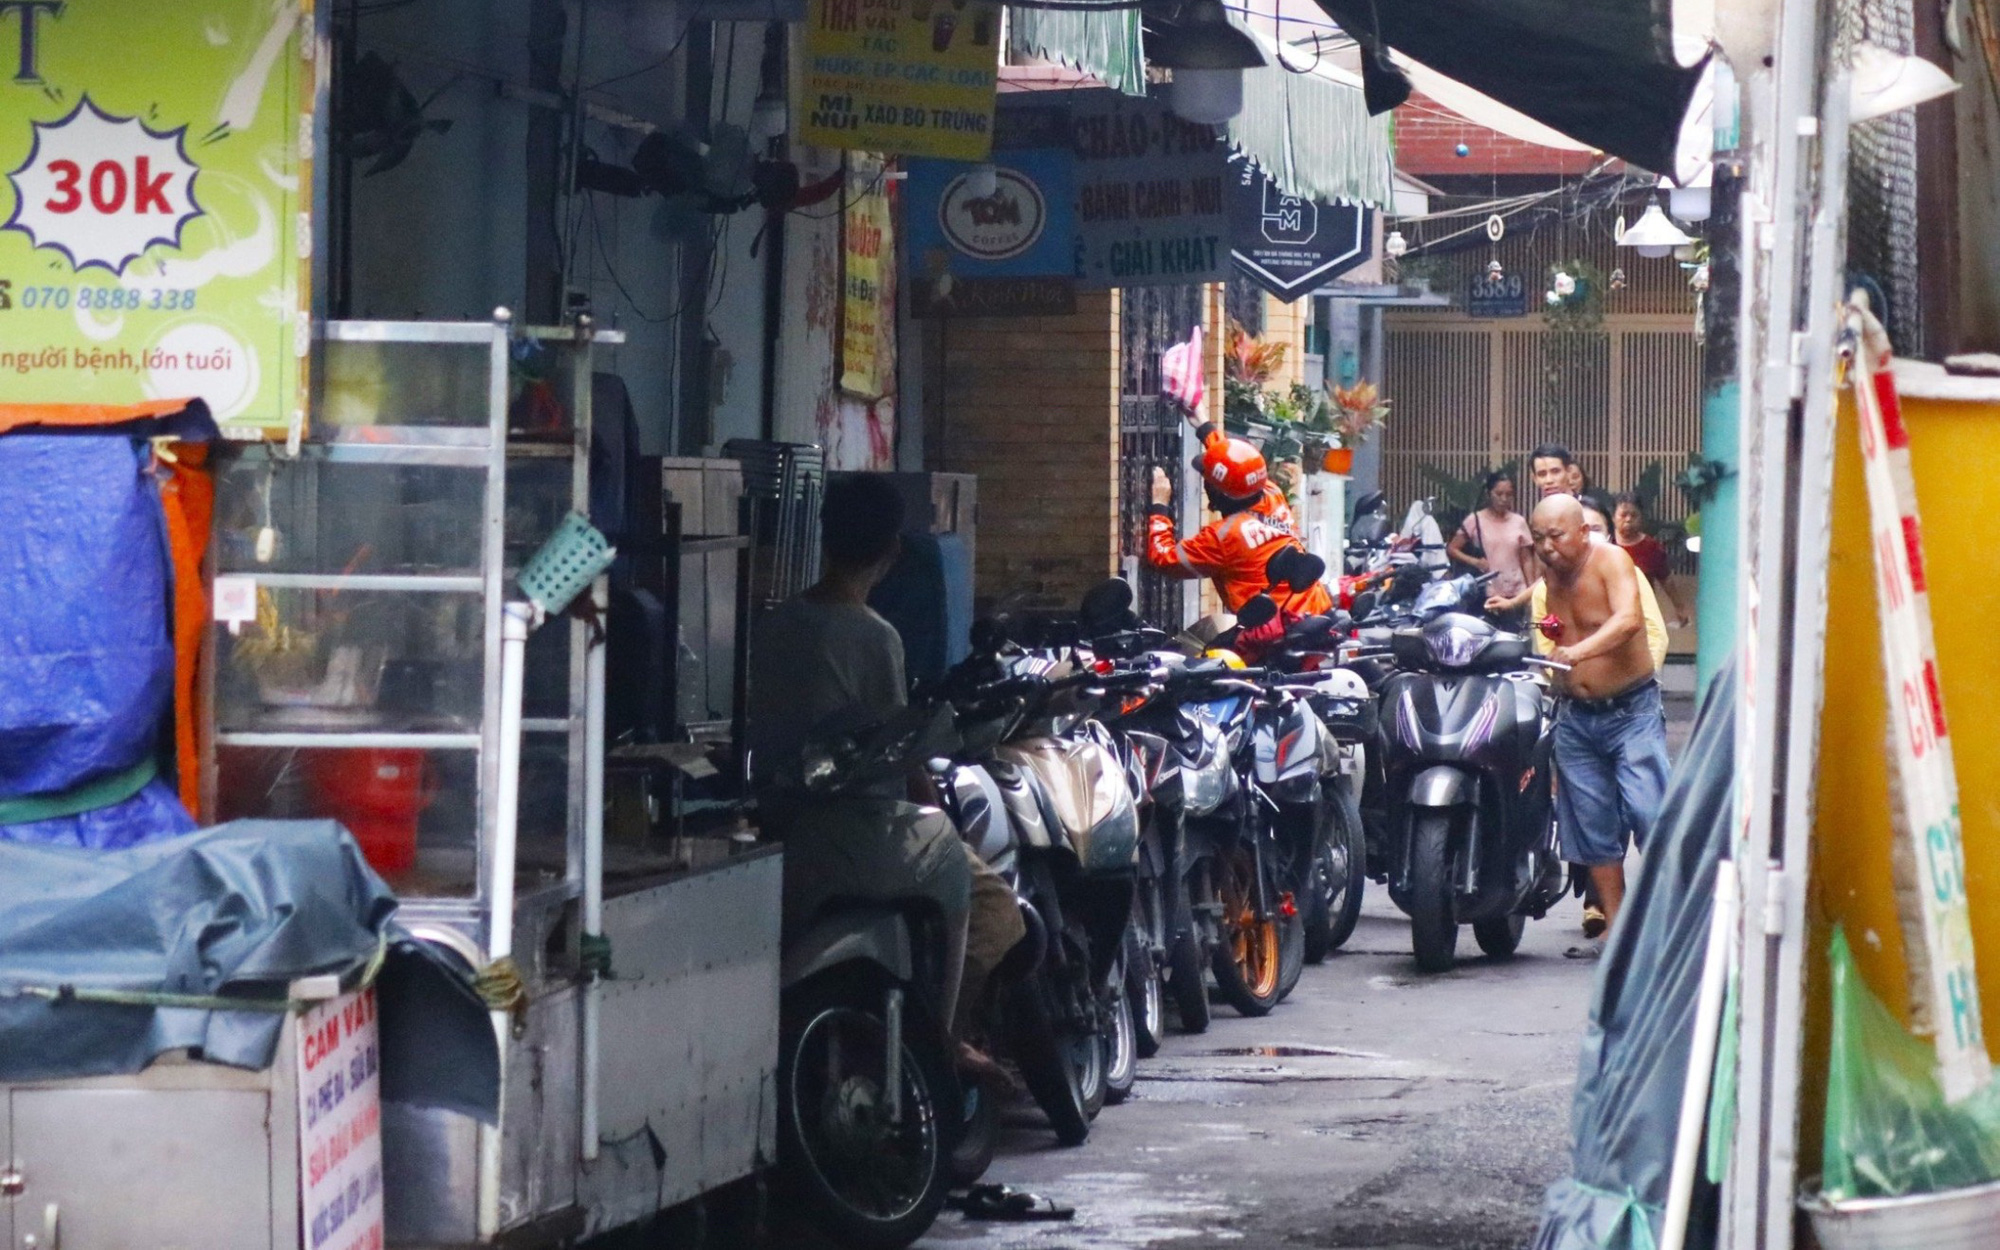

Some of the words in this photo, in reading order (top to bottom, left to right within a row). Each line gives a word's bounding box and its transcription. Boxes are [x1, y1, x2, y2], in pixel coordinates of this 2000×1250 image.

[44, 156, 175, 215] 30k
[22, 287, 70, 309] 070
[77, 288, 141, 310] 8888
[147, 289, 197, 311] 338
[1, 347, 67, 374] người
[186, 347, 232, 371] tuổi
[304, 1014, 339, 1071] CAM
